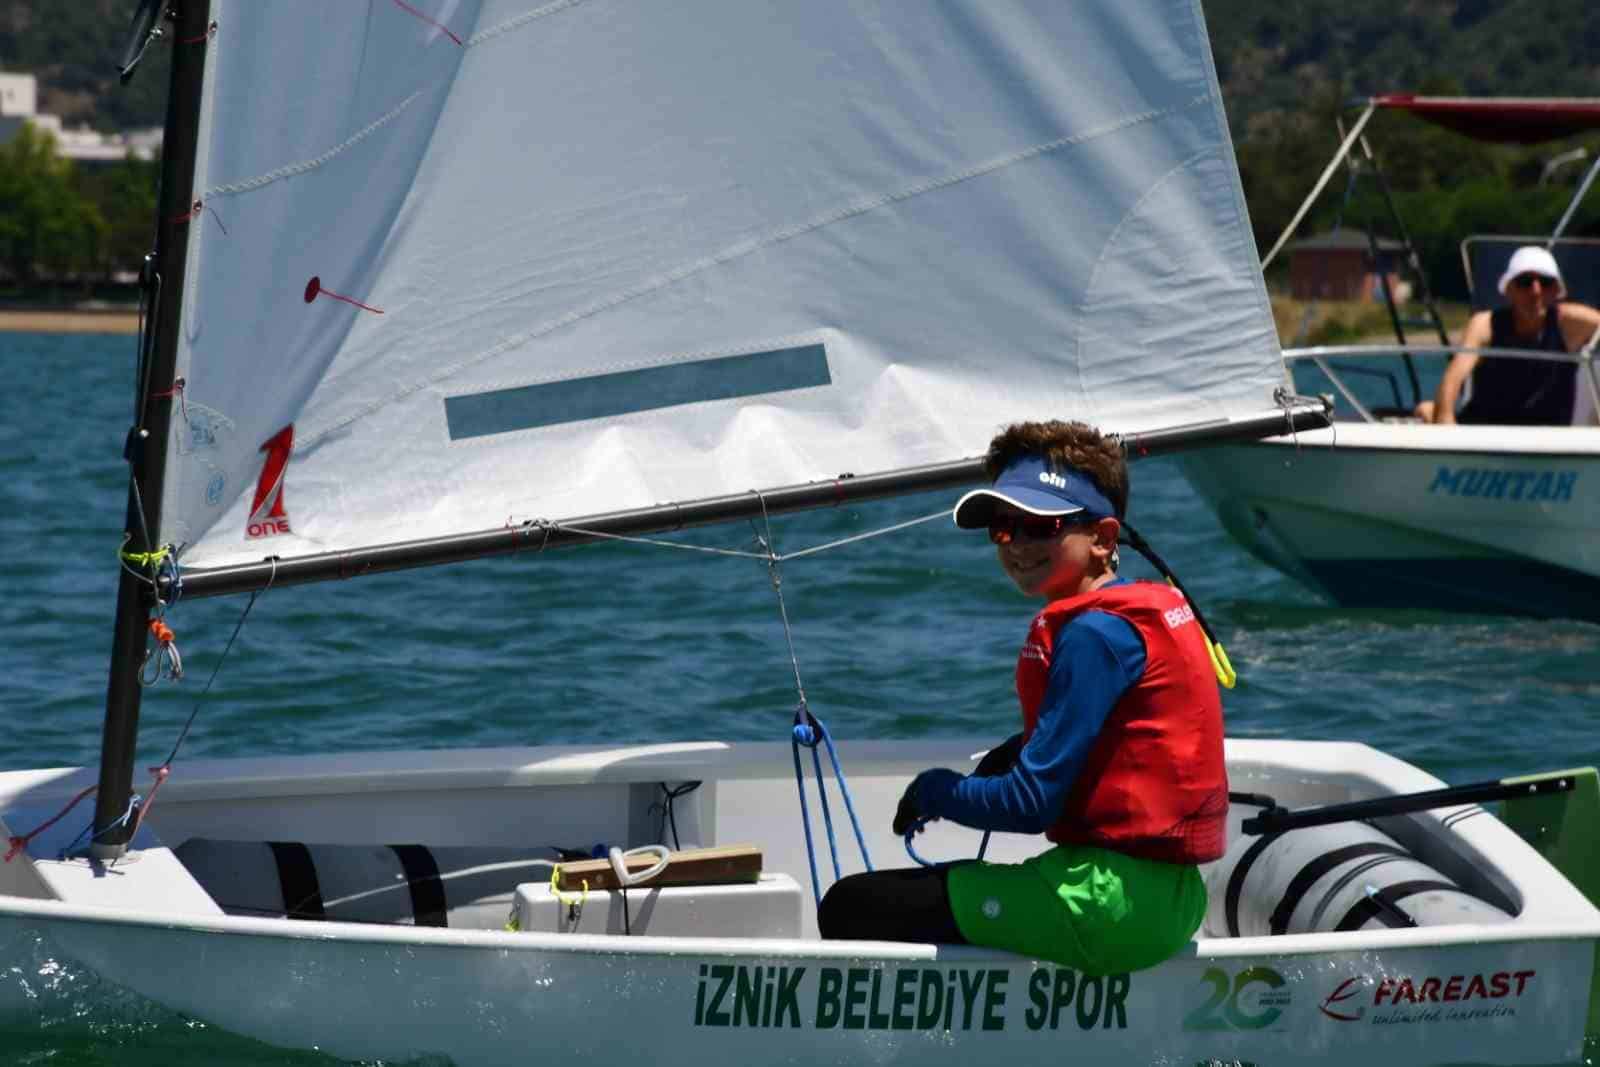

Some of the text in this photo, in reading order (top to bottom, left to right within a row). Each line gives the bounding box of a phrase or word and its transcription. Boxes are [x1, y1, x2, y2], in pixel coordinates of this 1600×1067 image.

[1025, 970, 1131, 1031] SPOR
[1373, 969, 1537, 1006] FAREAST
[1372, 1007, 1441, 1025] unlimited
